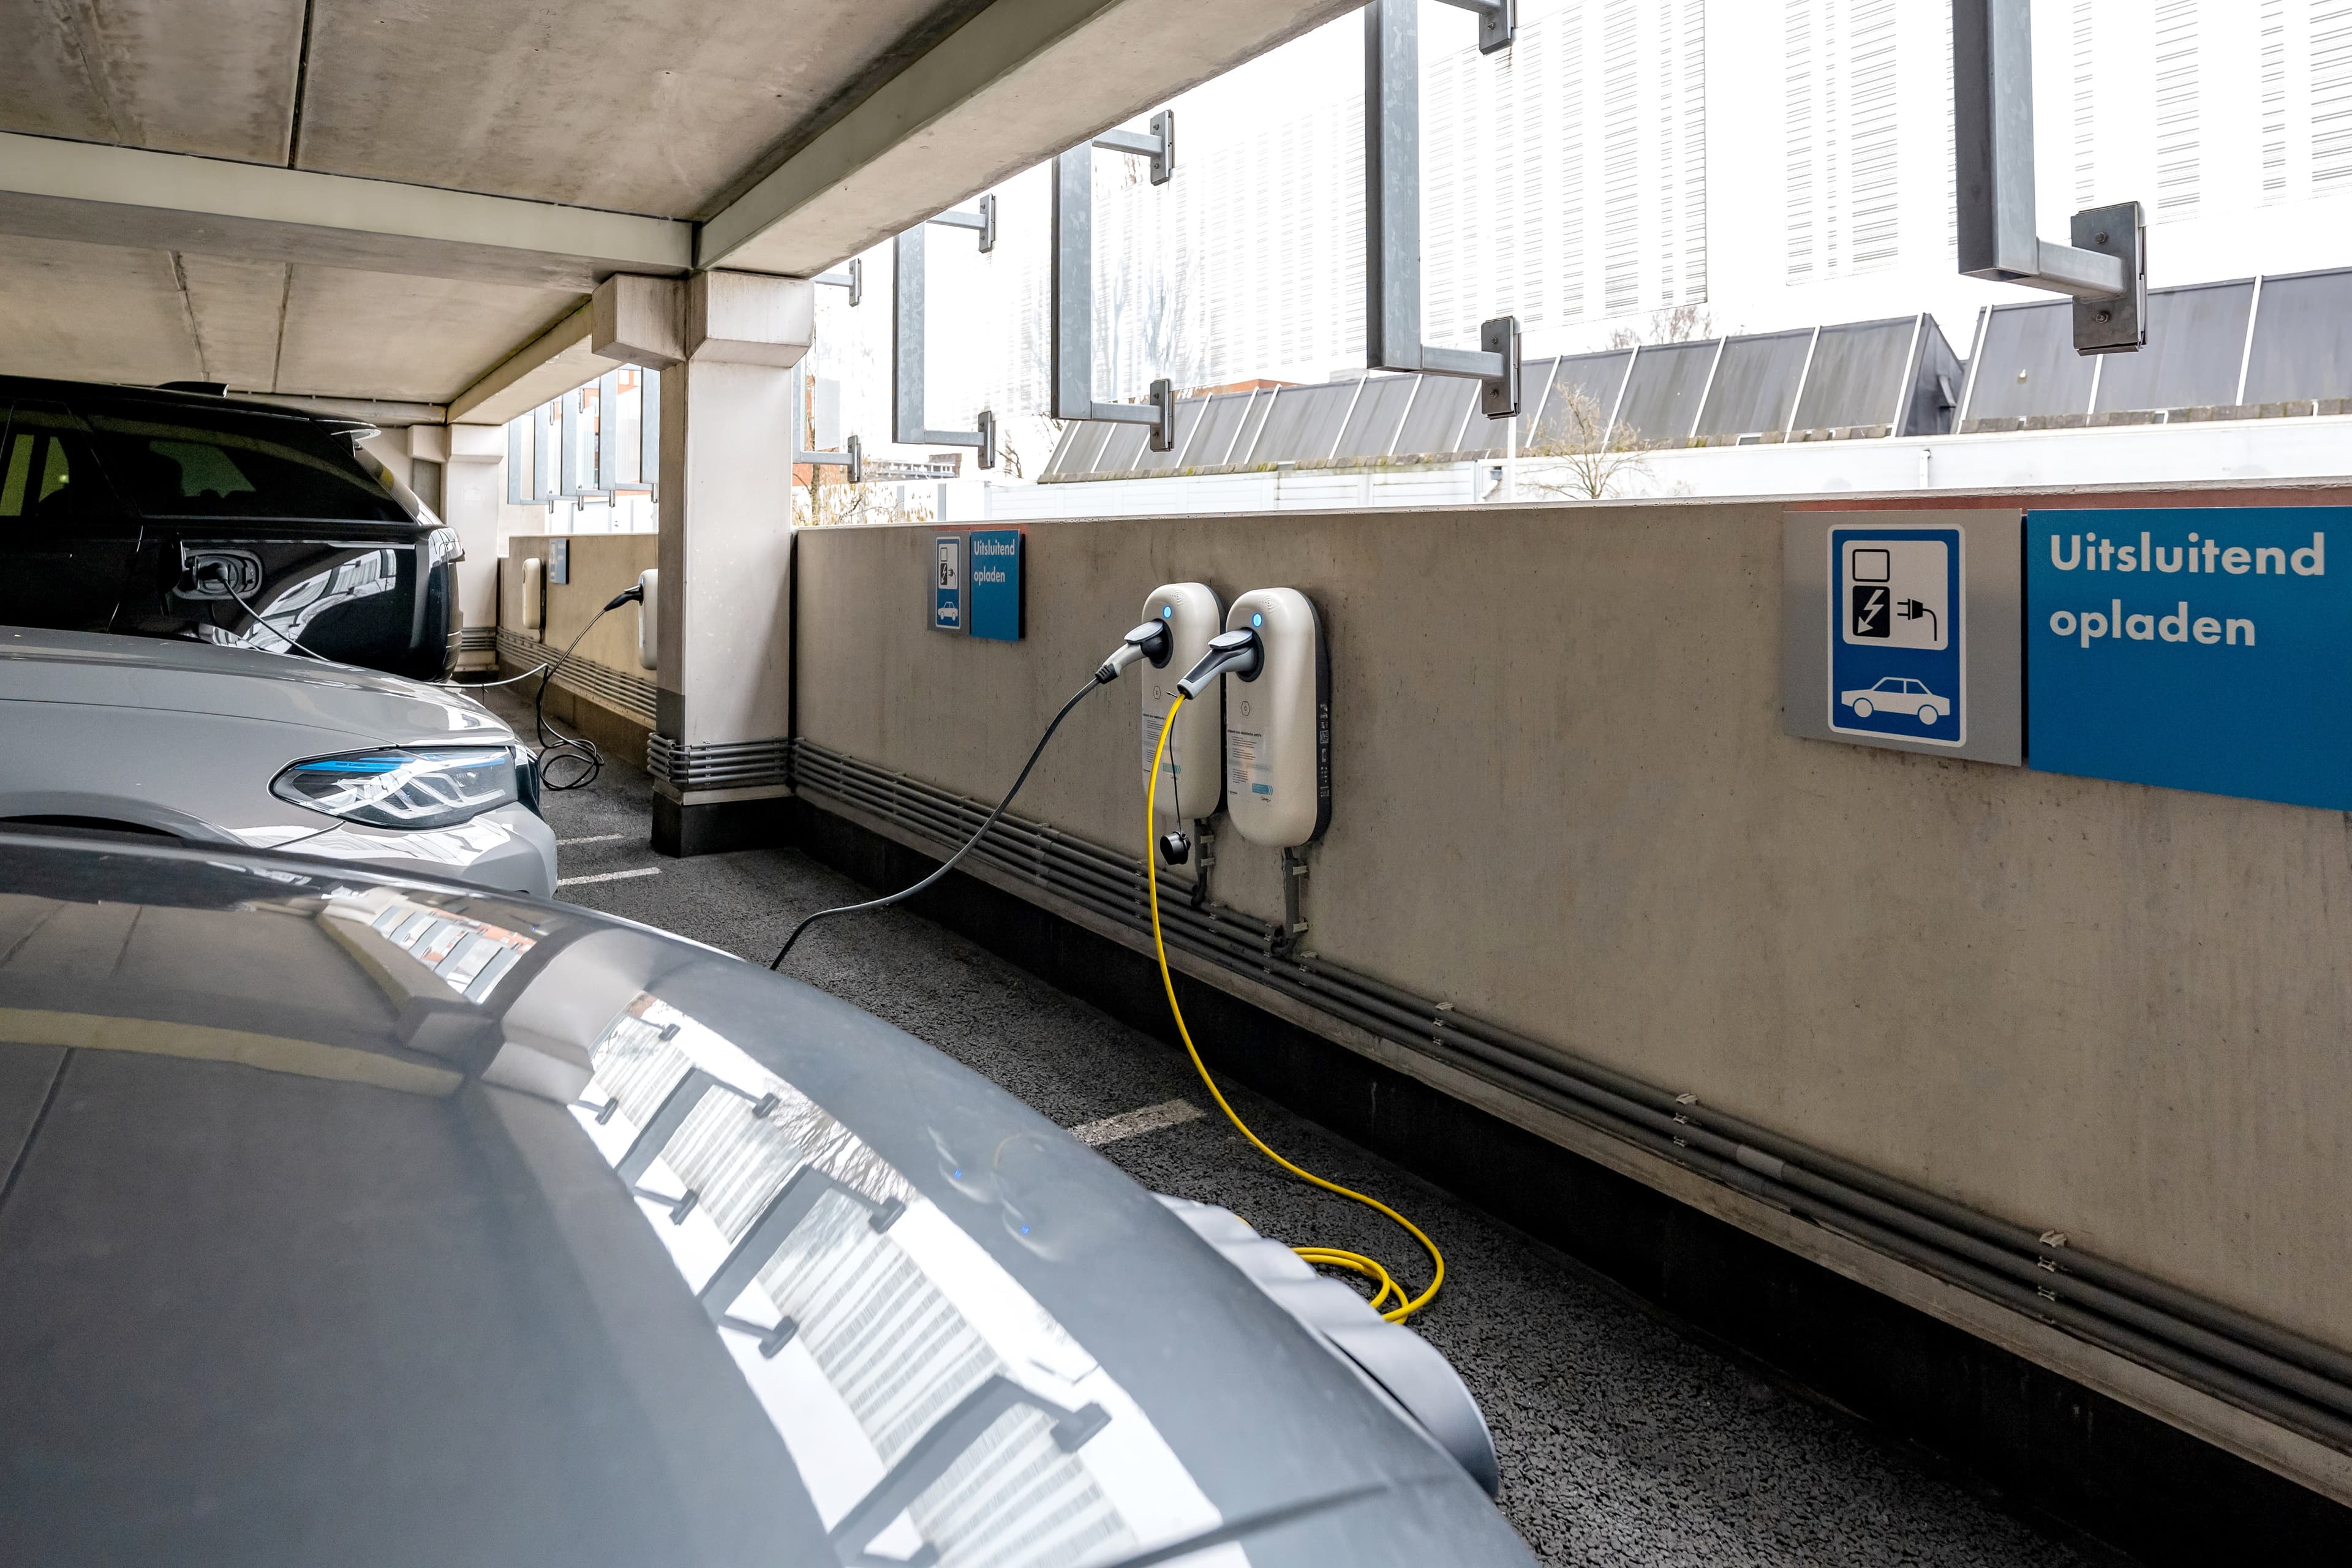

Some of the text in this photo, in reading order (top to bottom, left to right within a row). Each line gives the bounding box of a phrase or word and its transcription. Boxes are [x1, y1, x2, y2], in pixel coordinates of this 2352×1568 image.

[974, 539, 1015, 556] Uitsluitend
[2051, 532, 2325, 576] Uitsluitend
[974, 566, 1005, 586] opladen
[2049, 599, 2255, 649] opladen
